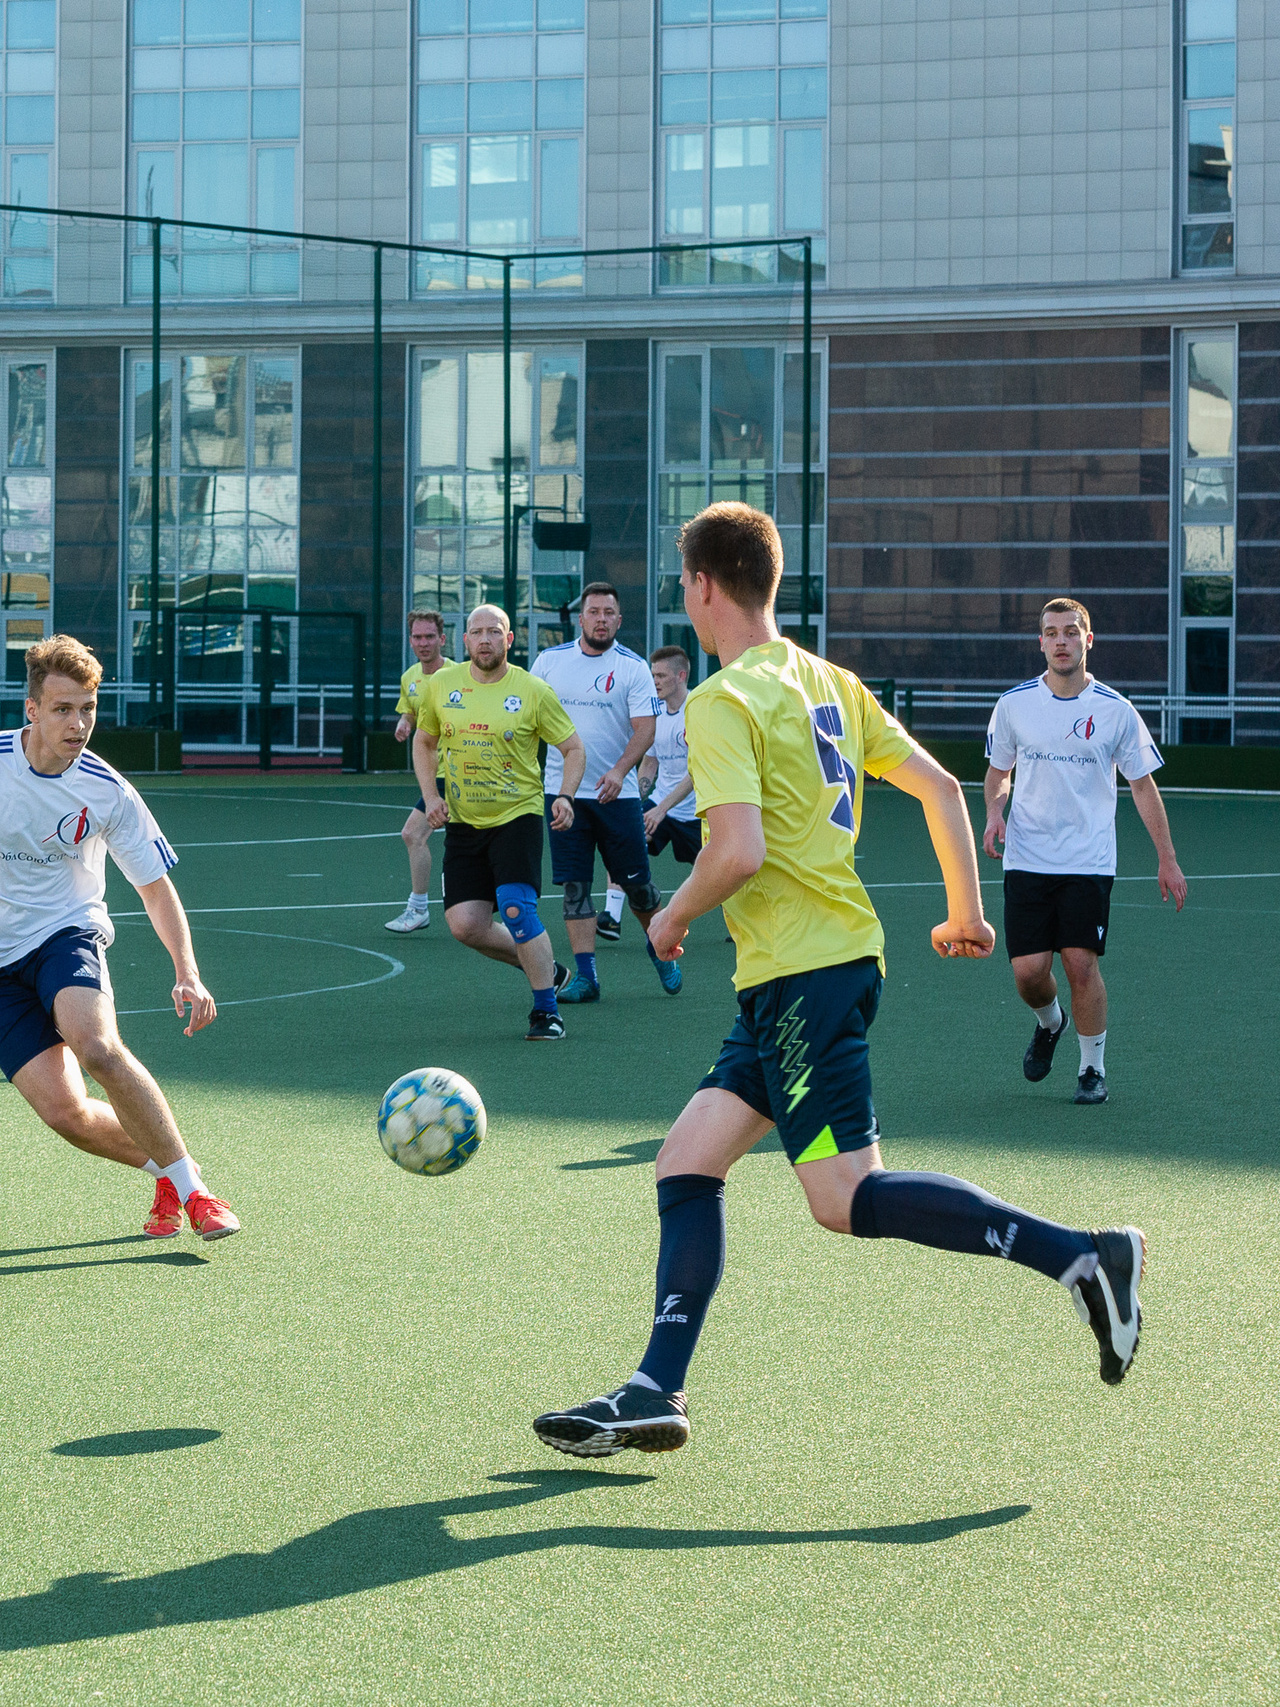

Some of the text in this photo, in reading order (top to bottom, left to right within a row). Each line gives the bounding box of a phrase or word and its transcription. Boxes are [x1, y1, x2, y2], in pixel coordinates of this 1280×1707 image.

[463, 739, 493, 748] ЭТАЛОН
[805, 702, 857, 837] 5
[654, 1313, 689, 1325] ZEUS
